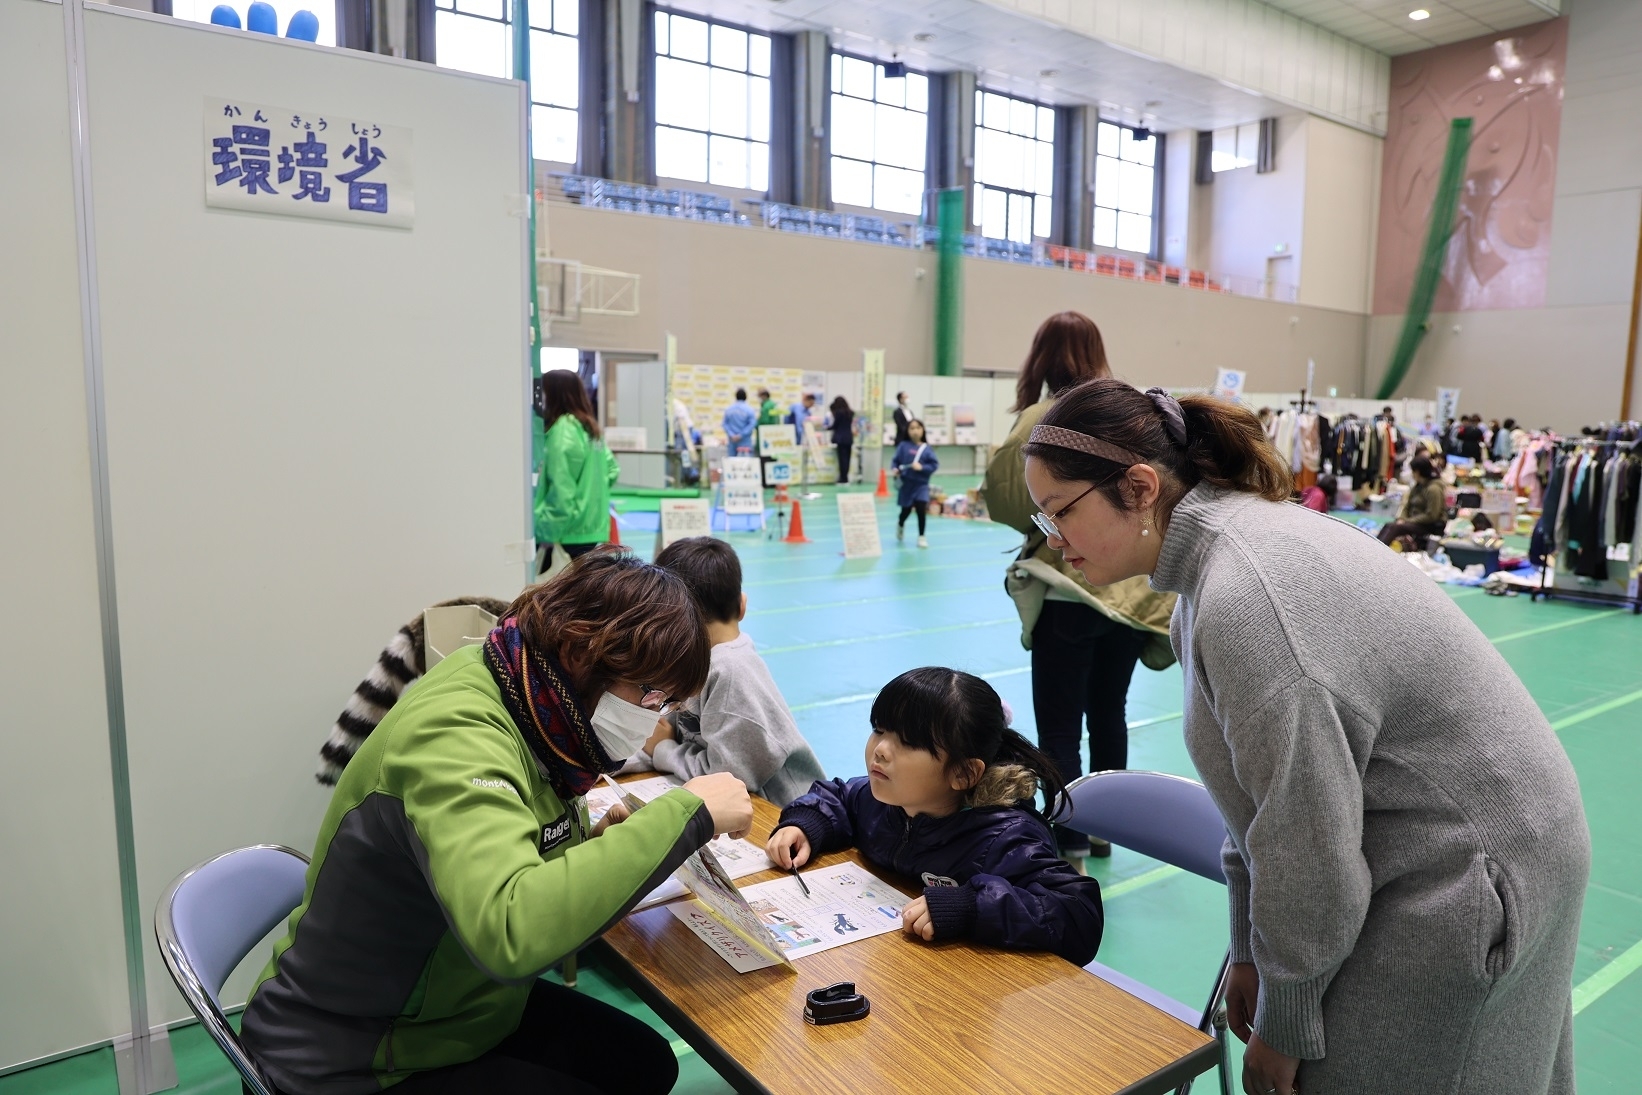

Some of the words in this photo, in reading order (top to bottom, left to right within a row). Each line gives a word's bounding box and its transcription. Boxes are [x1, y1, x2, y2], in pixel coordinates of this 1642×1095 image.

[224, 104, 268, 123] かん
[290, 115, 327, 131] きょう
[351, 122, 381, 138] しょう
[212, 125, 387, 213] 環境省
